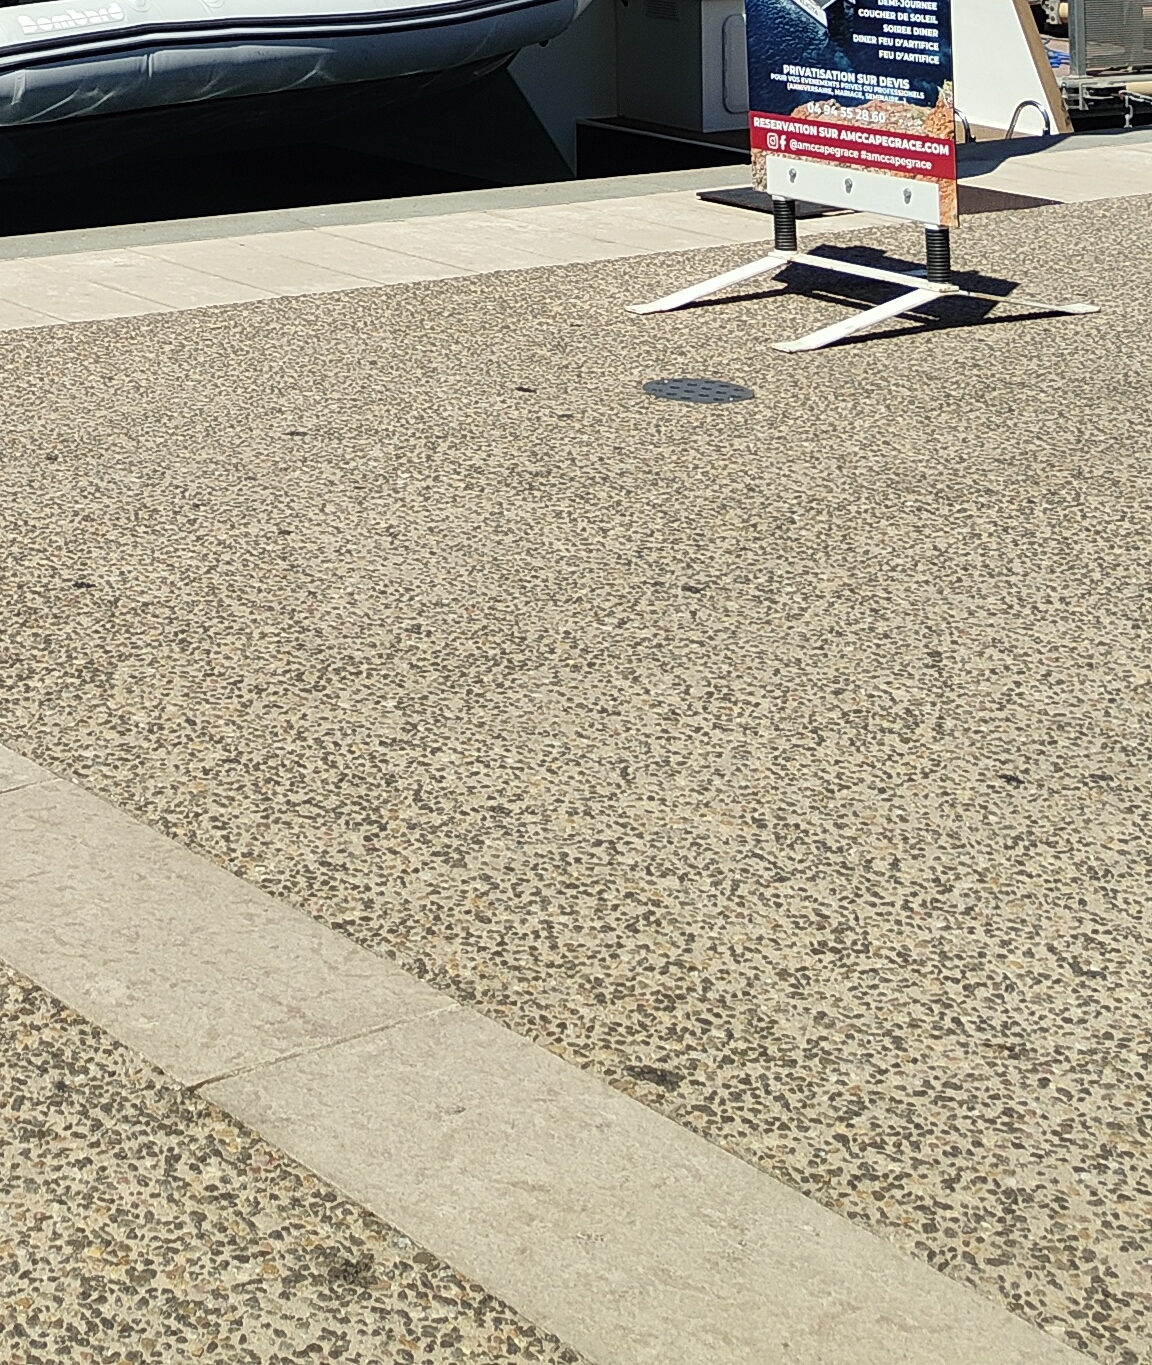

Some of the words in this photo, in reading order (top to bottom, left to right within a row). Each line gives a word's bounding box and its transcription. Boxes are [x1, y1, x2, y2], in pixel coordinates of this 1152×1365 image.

[17, 2, 125, 35] Bombard
[858, 8, 896, 21] COUCHER
[897, 12, 909, 21] DE
[910, 13, 939, 24] SOLEIL
[882, 24, 912, 35] SOIREE
[913, 27, 939, 37] DINER
[852, 34, 877, 45] DINER
[878, 36, 894, 46] FEU
[894, 38, 939, 51] D'ARTIFICE
[878, 50, 894, 59] FEU
[895, 52, 940, 65] D'ARTIFICE
[770, 73, 788, 81] POUR
[788, 75, 800, 83] VOS
[783, 64, 856, 84] PRIVATISATION
[857, 73, 877, 86] SUR
[879, 76, 910, 89] DEVIS
[807, 102, 821, 114] 04
[824, 105, 838, 117] 94
[840, 107, 853, 119] 55
[855, 109, 869, 121] 28
[871, 111, 886, 123] 60
[753, 117, 817, 136] RESERVATION
[818, 126, 839, 140] SUR
[839, 130, 950, 156] AMCCAPEGRACE.COM
[789, 139, 859, 159] @amccapegrace
[860, 150, 932, 170] #amccapegrace
